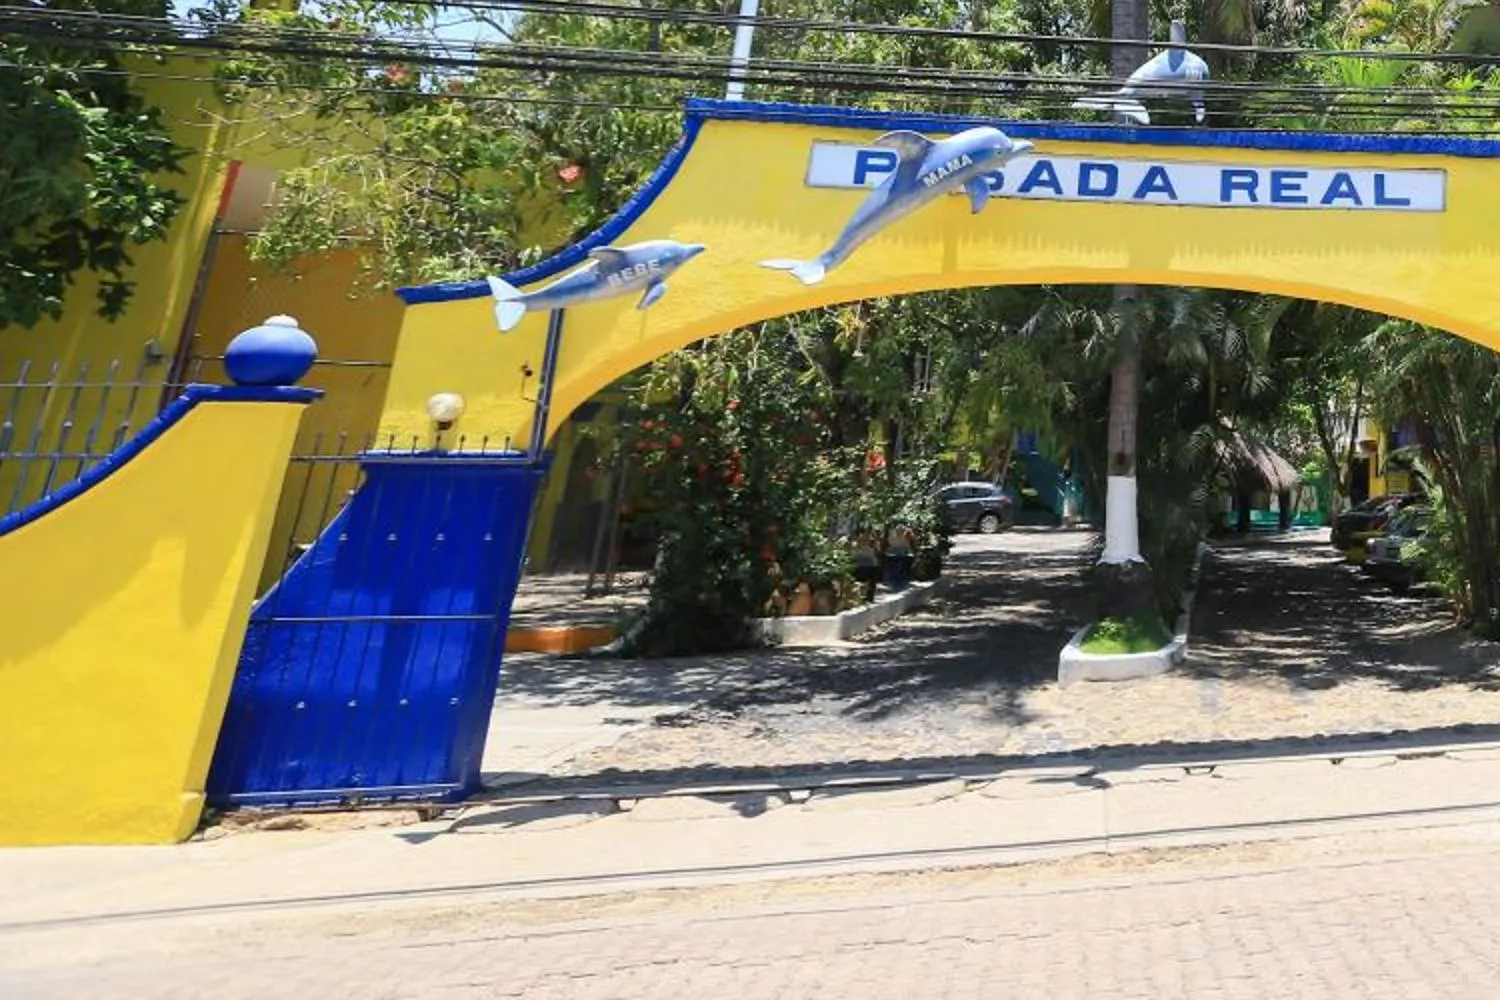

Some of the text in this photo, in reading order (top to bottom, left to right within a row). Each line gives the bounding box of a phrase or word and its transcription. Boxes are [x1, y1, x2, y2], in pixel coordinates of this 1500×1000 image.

[853, 149, 1412, 207] PADA REAL
[922, 153, 973, 187] MAMA
[607, 258, 661, 286] BEBE
